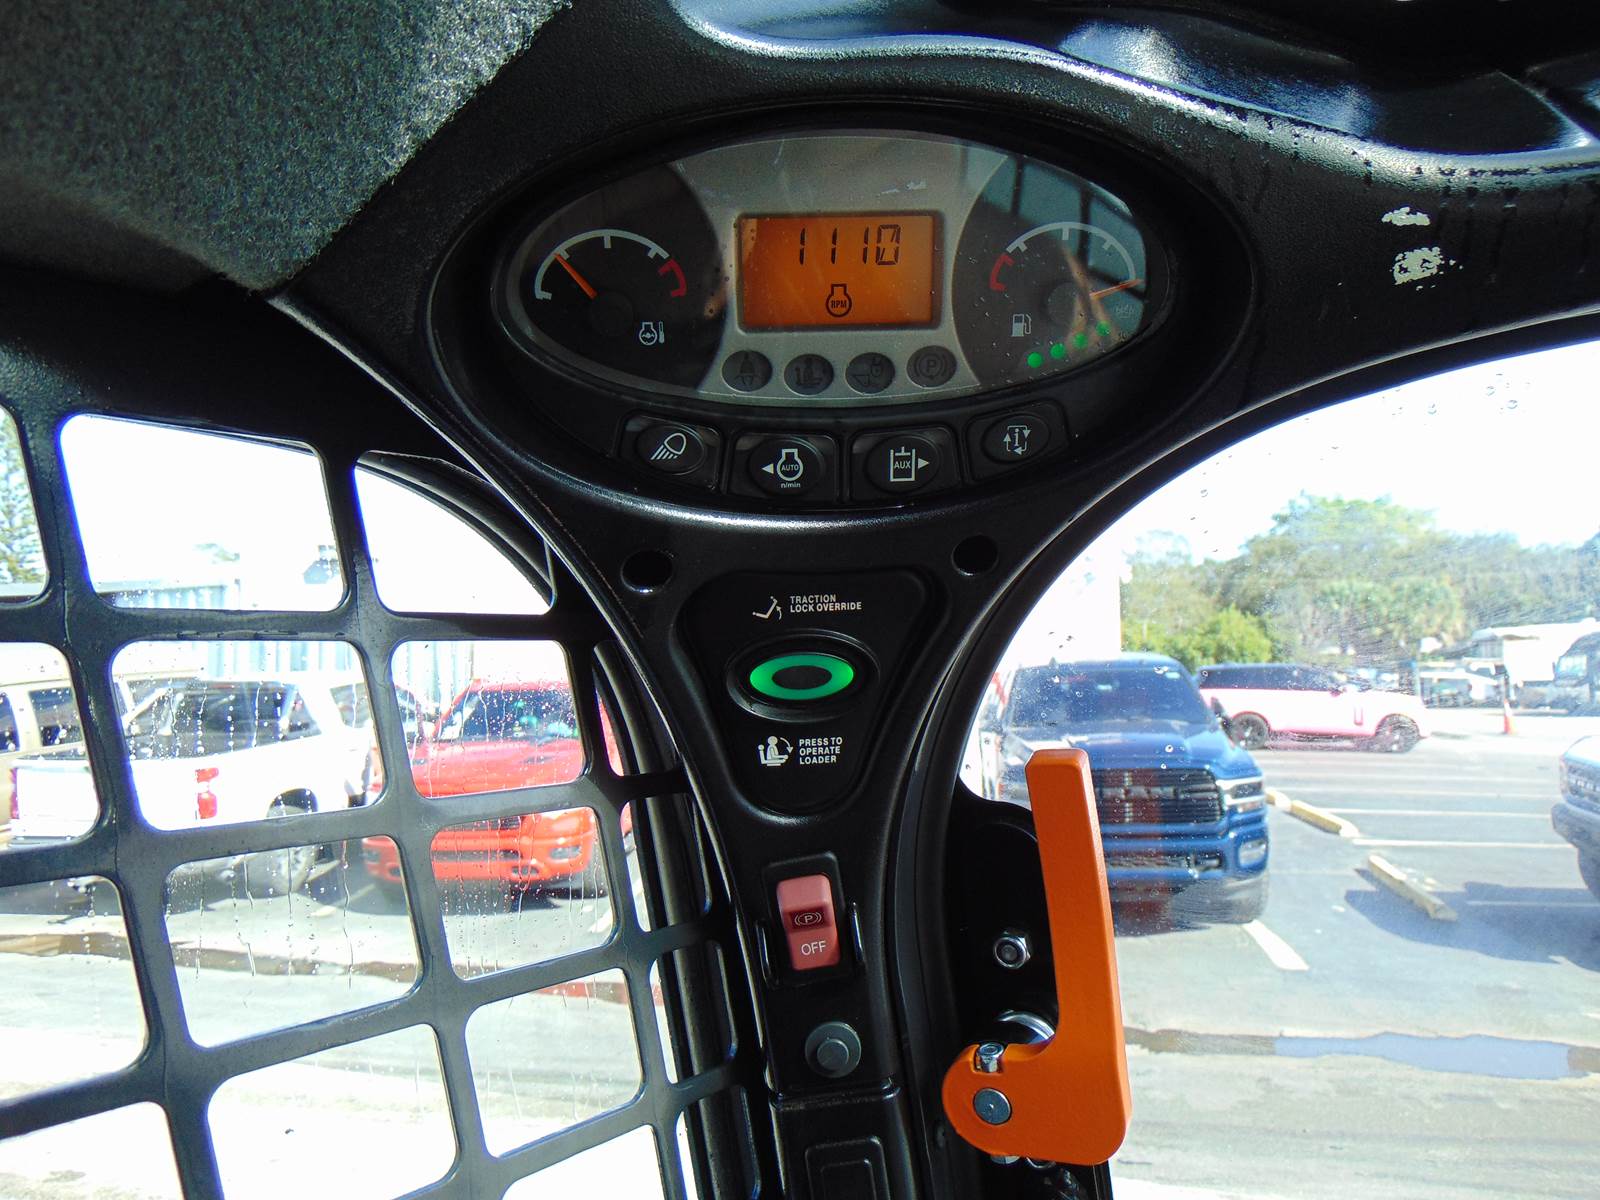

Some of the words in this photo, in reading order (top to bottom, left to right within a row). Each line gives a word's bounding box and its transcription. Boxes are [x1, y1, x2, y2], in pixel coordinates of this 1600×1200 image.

[799, 224, 901, 266] 1110
[830, 299, 848, 309] RPM
[893, 460, 912, 469] AUX
[789, 594, 837, 604] TRACTION
[789, 604, 815, 613] LOCK
[816, 602, 862, 611] OVERRIDE
[799, 738, 829, 747] PRESS
[830, 736, 843, 745] TO
[799, 746, 841, 756] OPERATE
[799, 755, 837, 765] LOADER
[801, 940, 827, 956] OFF
